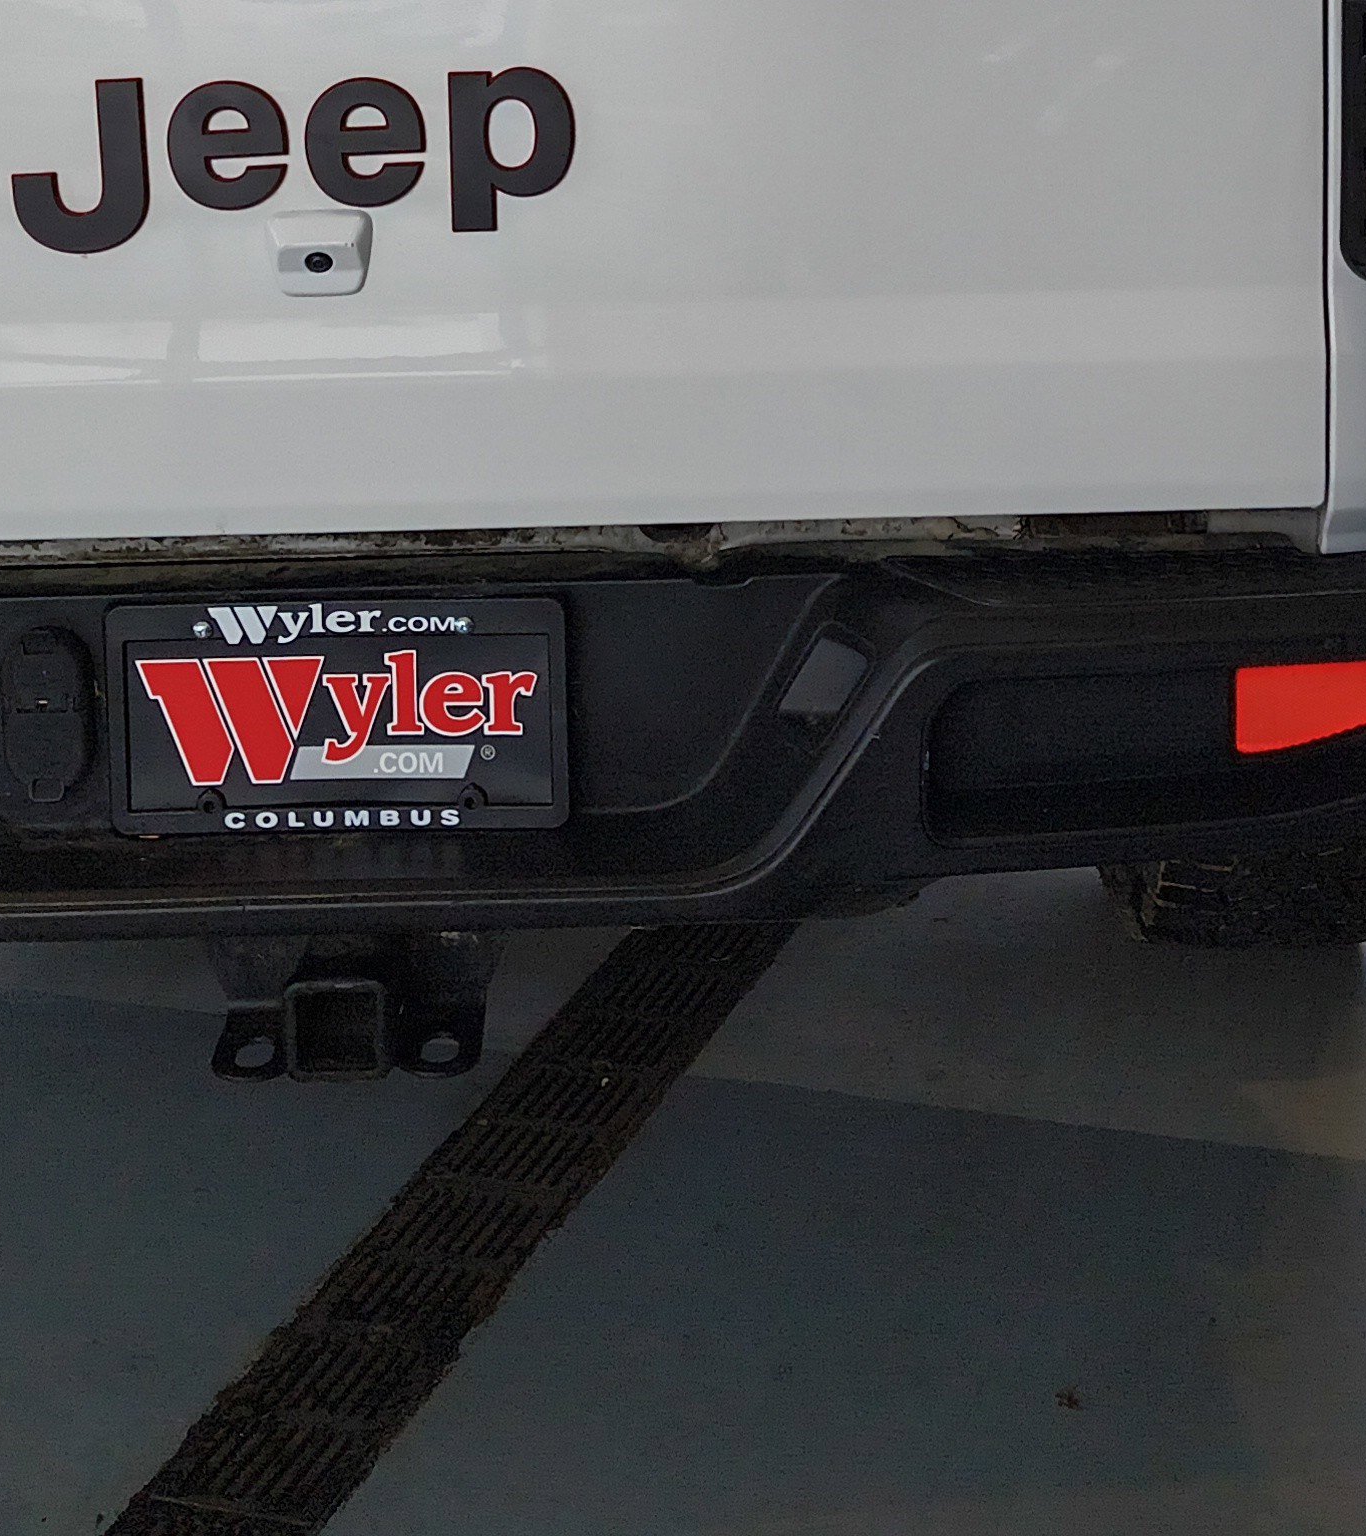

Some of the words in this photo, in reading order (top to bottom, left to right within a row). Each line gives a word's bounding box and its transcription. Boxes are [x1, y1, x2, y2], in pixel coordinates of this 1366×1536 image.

[12, 67, 575, 253] Jeep
[135, 650, 537, 785] Wyler
[373, 752, 443, 773] .COM
[224, 809, 460, 829] COLUMBUS
